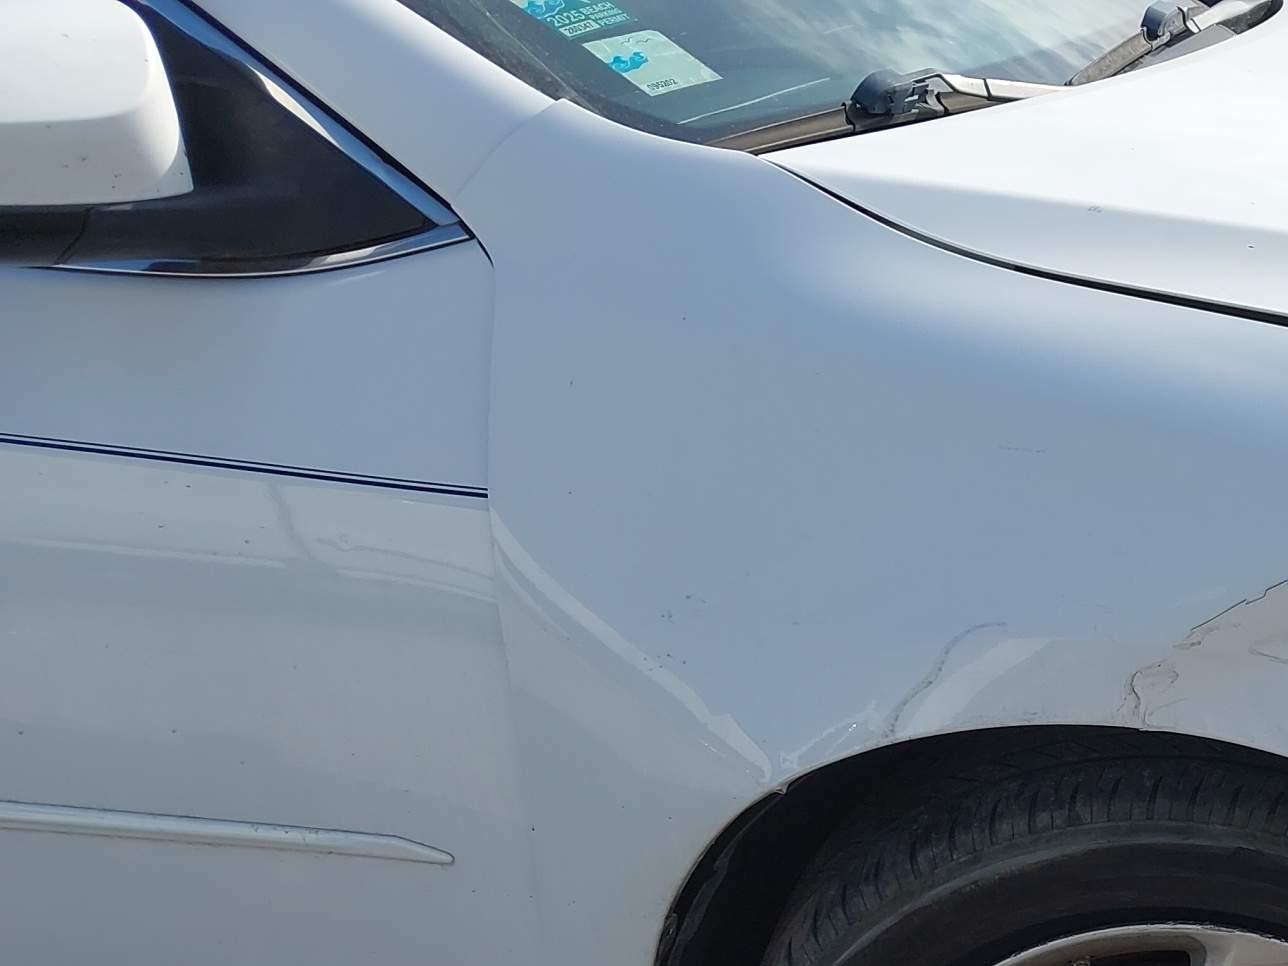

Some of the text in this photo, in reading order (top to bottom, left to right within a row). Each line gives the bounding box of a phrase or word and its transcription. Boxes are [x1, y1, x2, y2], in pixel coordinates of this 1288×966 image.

[546, 1, 615, 27] 2025 BEACH
[589, 8, 623, 20] PARKING
[597, 13, 630, 26] PERMIT
